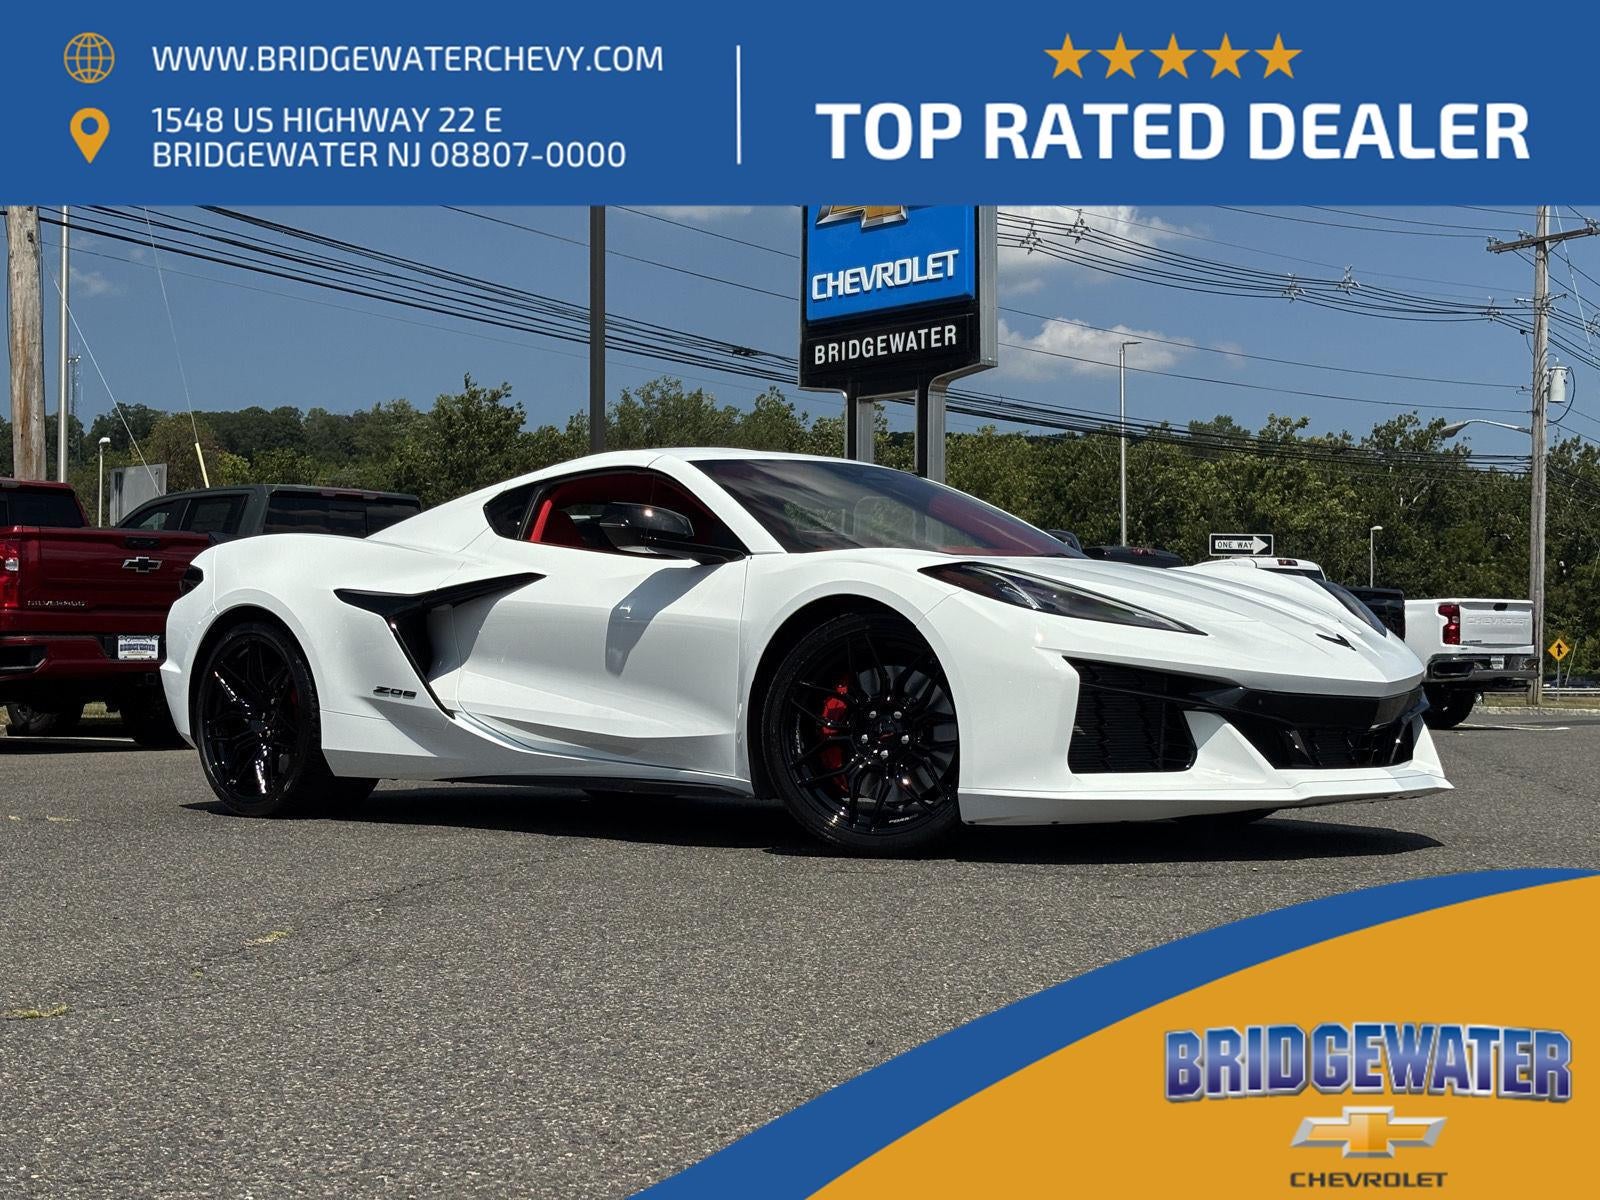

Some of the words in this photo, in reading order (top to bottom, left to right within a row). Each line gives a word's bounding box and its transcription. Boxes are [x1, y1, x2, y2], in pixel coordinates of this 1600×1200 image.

[812, 249, 959, 301] CHEVROLET
[814, 325, 957, 365] BRIDGEWATER
[1217, 541, 1233, 549] ONE
[1237, 541, 1253, 549] WAY
